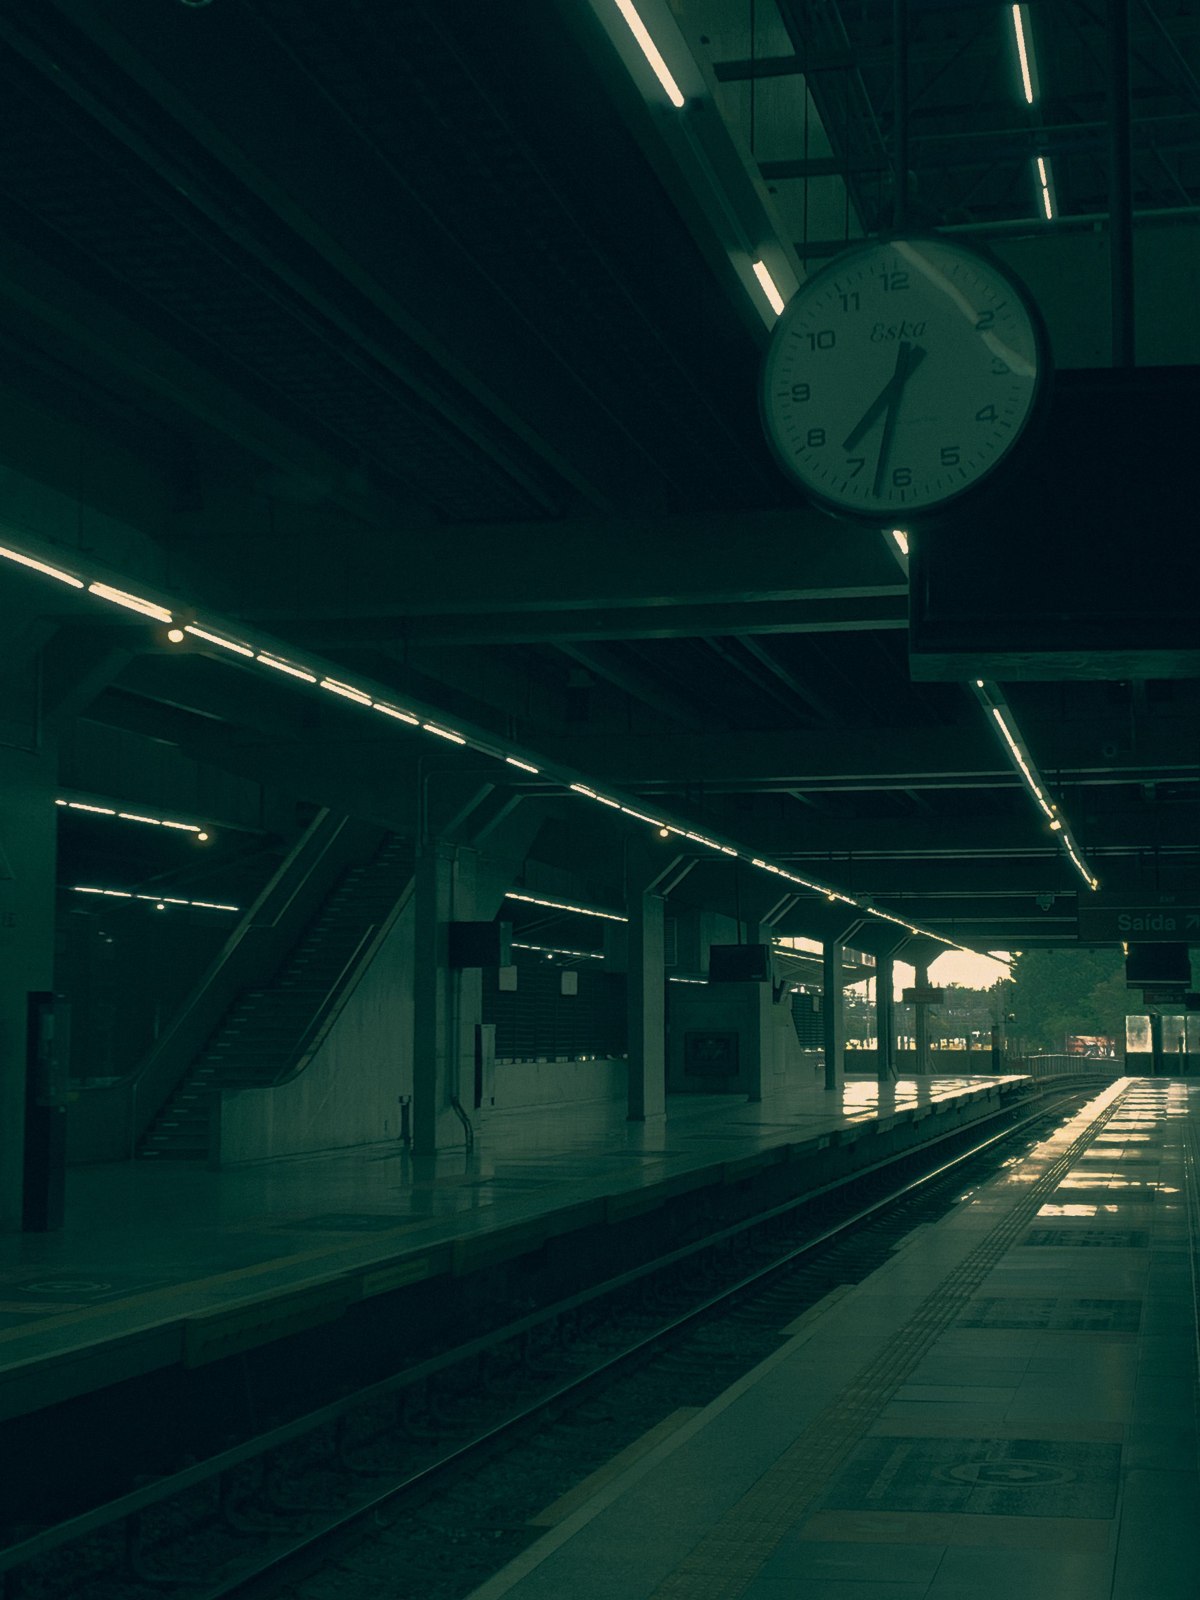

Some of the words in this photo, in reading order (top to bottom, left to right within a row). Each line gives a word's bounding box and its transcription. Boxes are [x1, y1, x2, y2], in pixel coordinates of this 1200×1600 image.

[880, 272, 909, 291] 12
[839, 292, 860, 312] 11
[975, 311, 994, 330] 2
[807, 330, 836, 351] 10
[870, 320, 926, 343] Eska
[791, 383, 810, 402] 9
[975, 405, 999, 424] 4
[807, 428, 826, 447] 8
[940, 446, 960, 466] 5
[846, 458, 865, 478] 7
[892, 467, 912, 487] 6
[1117, 913, 1176, 931] Saída
